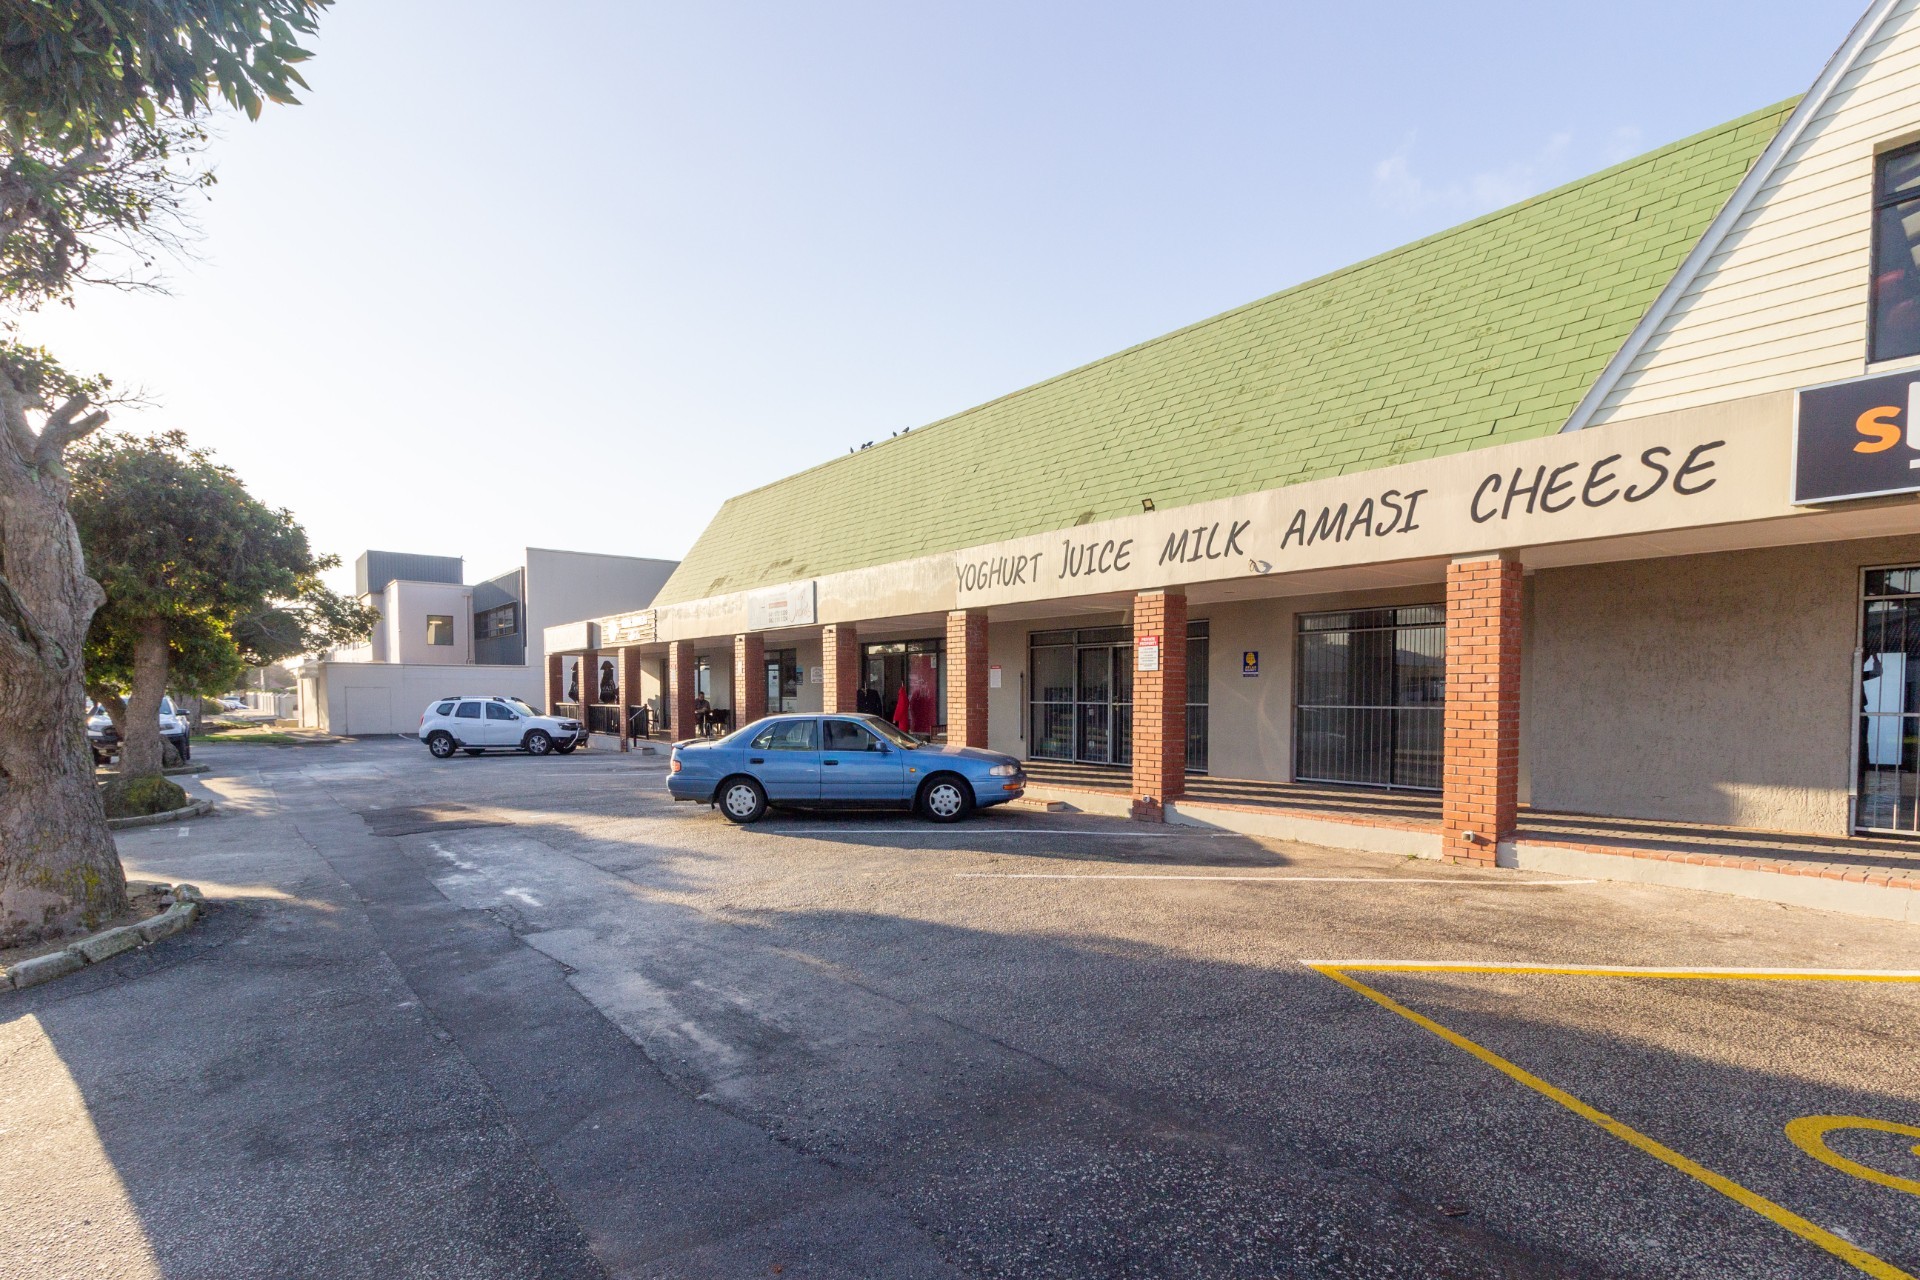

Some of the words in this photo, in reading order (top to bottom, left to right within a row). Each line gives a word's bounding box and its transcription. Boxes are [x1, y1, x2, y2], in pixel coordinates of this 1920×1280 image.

[956, 552, 1043, 593] YOGHURT
[1058, 538, 1134, 580] JUICE
[1158, 519, 1251, 566] MILK
[1280, 489, 1429, 550] AMASI
[1470, 440, 1726, 524] CHEESE
